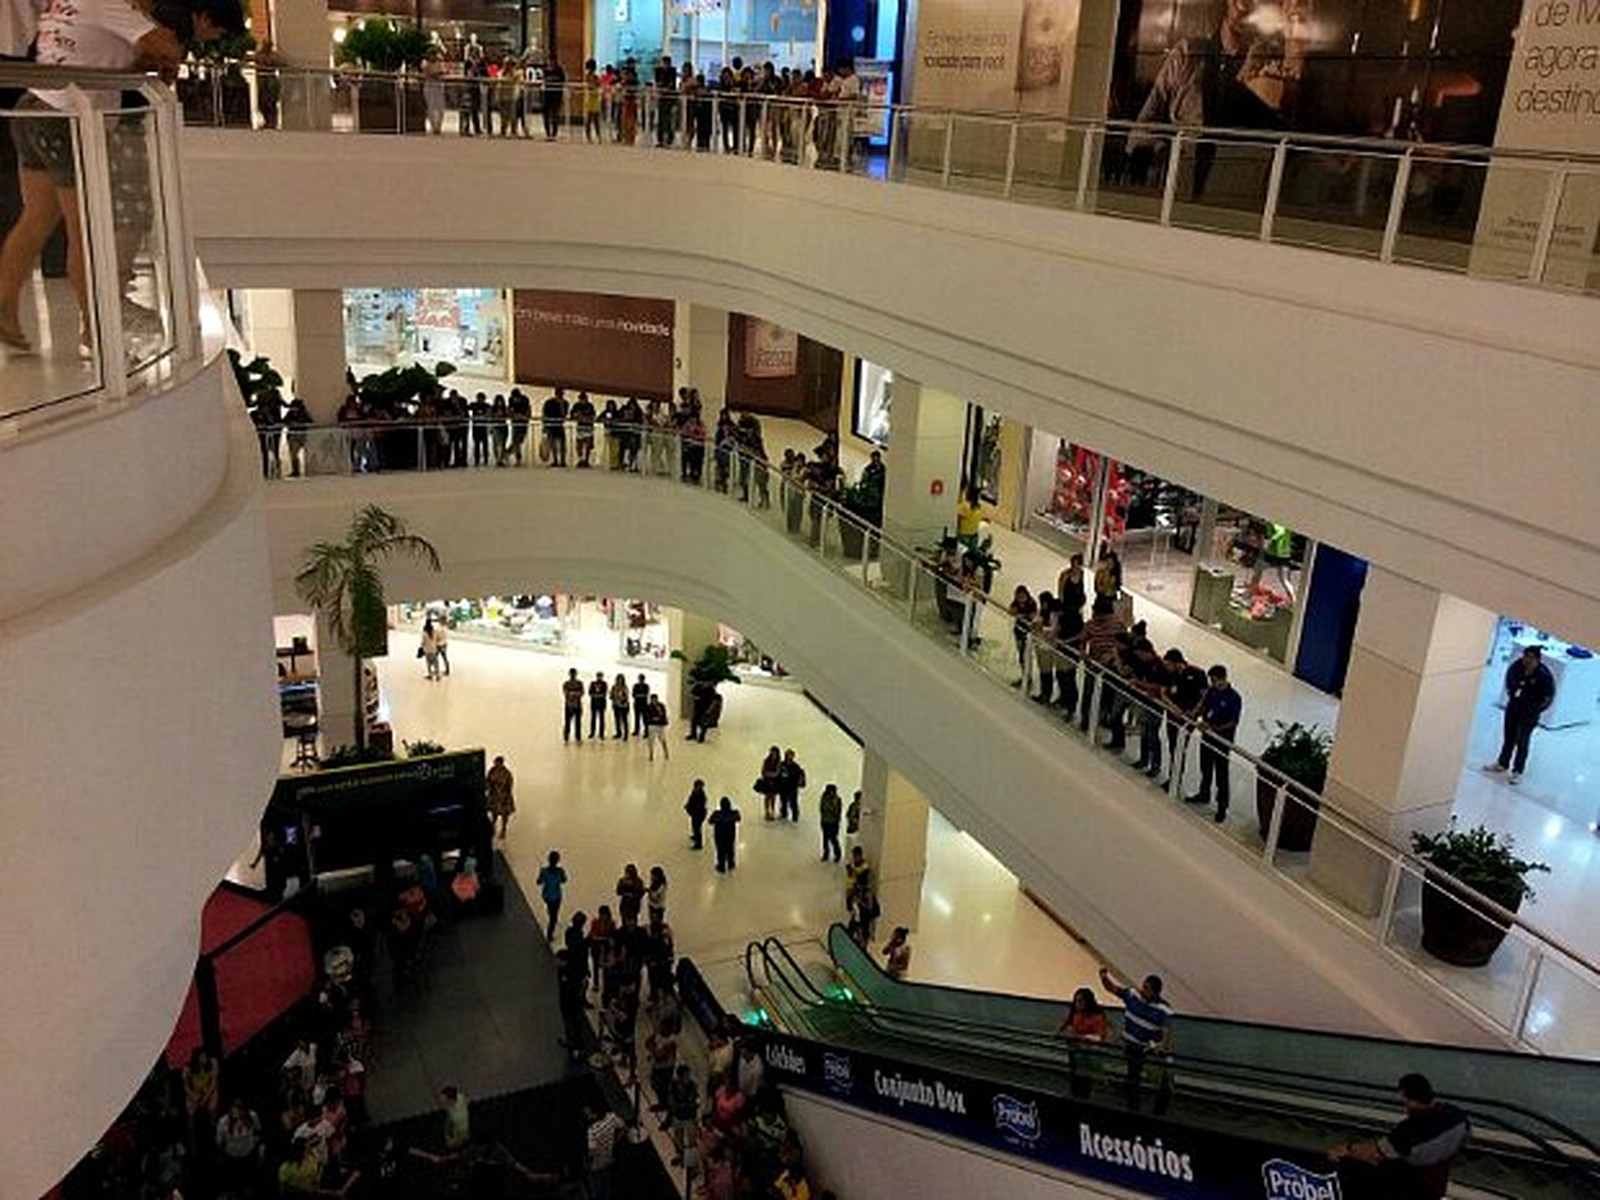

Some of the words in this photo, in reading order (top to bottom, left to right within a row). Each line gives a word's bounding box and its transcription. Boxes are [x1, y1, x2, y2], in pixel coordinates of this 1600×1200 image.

[1535, 0, 1570, 27] de
[1524, 45, 1598, 78] agora
[874, 1069, 935, 1108] Conjunto
[935, 1080, 967, 1115] Box
[1079, 1122, 1194, 1183] Acessórios
